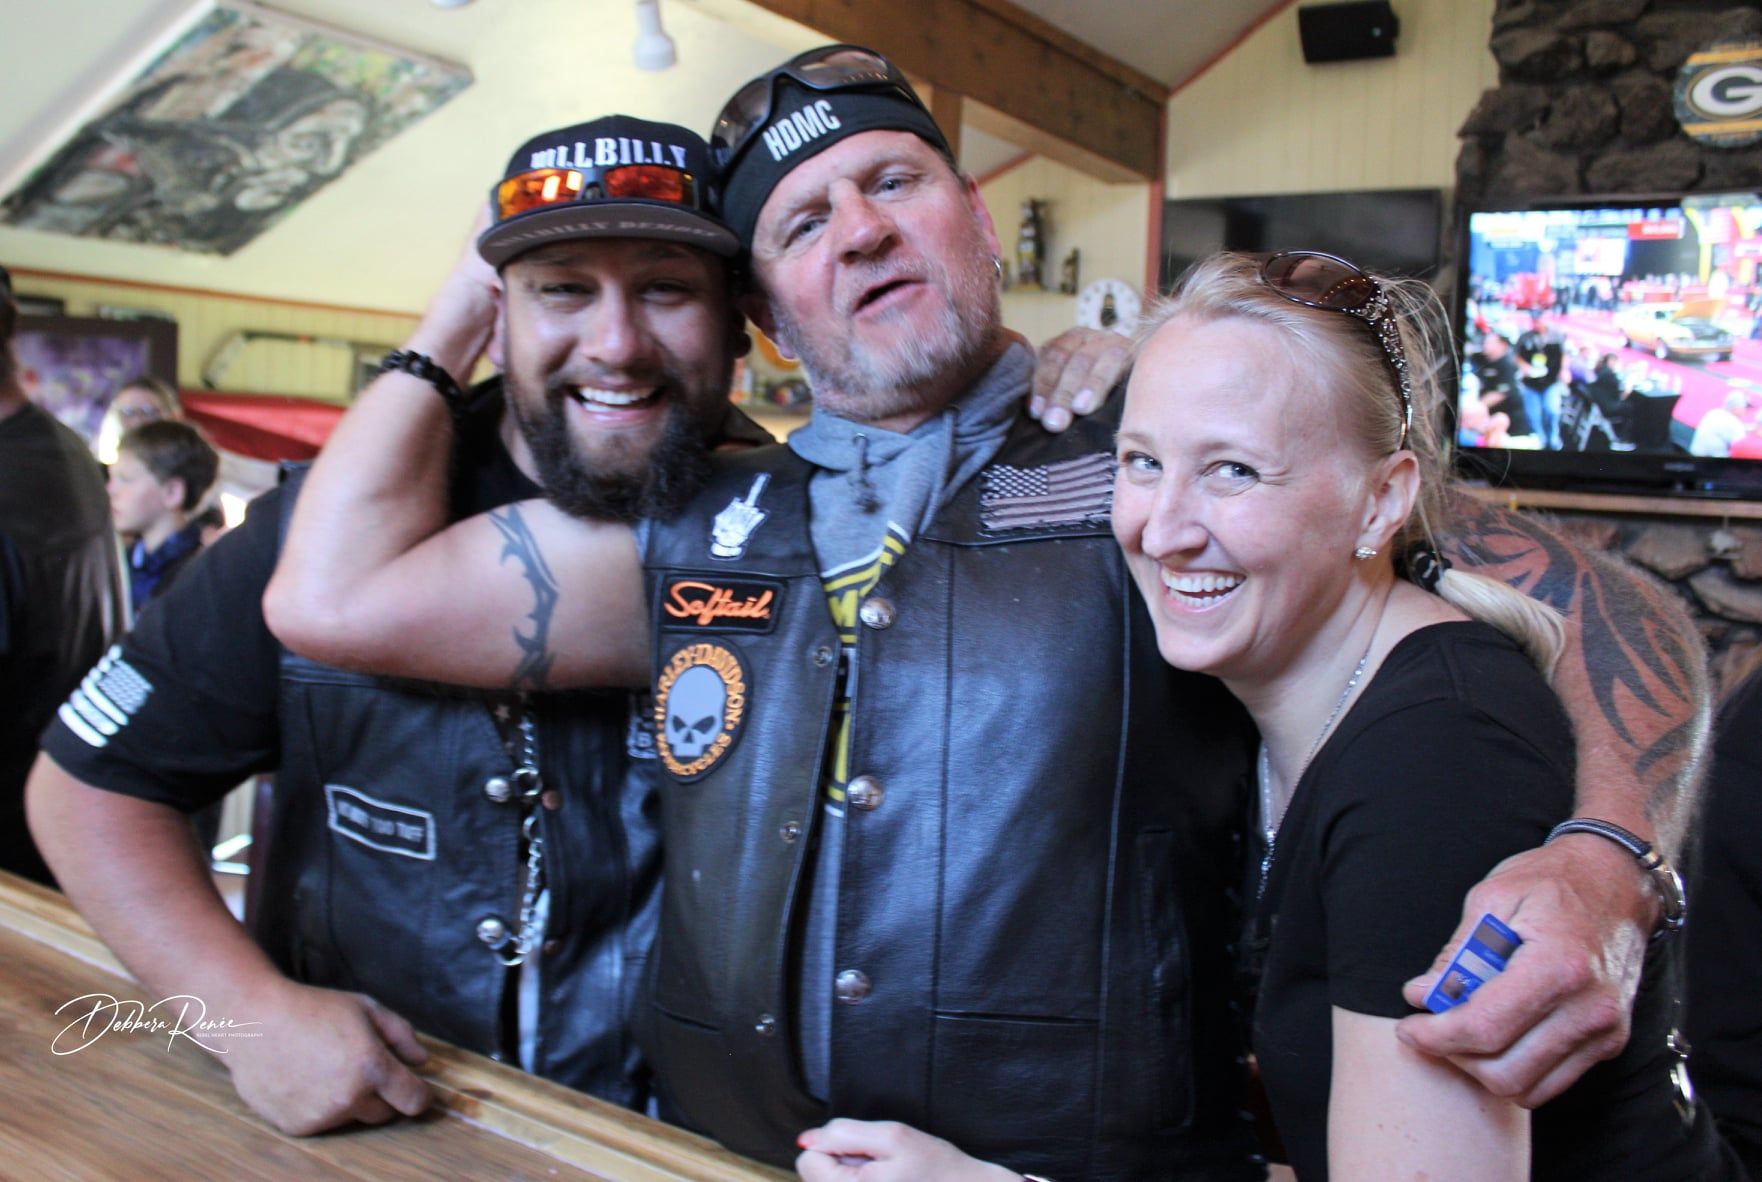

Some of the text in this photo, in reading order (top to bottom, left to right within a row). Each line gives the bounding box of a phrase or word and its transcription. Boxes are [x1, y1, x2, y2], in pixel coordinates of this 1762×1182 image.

[1691, 66, 1762, 116] G
[530, 136, 687, 169] HILLBILLY
[762, 99, 842, 161] HDMC
